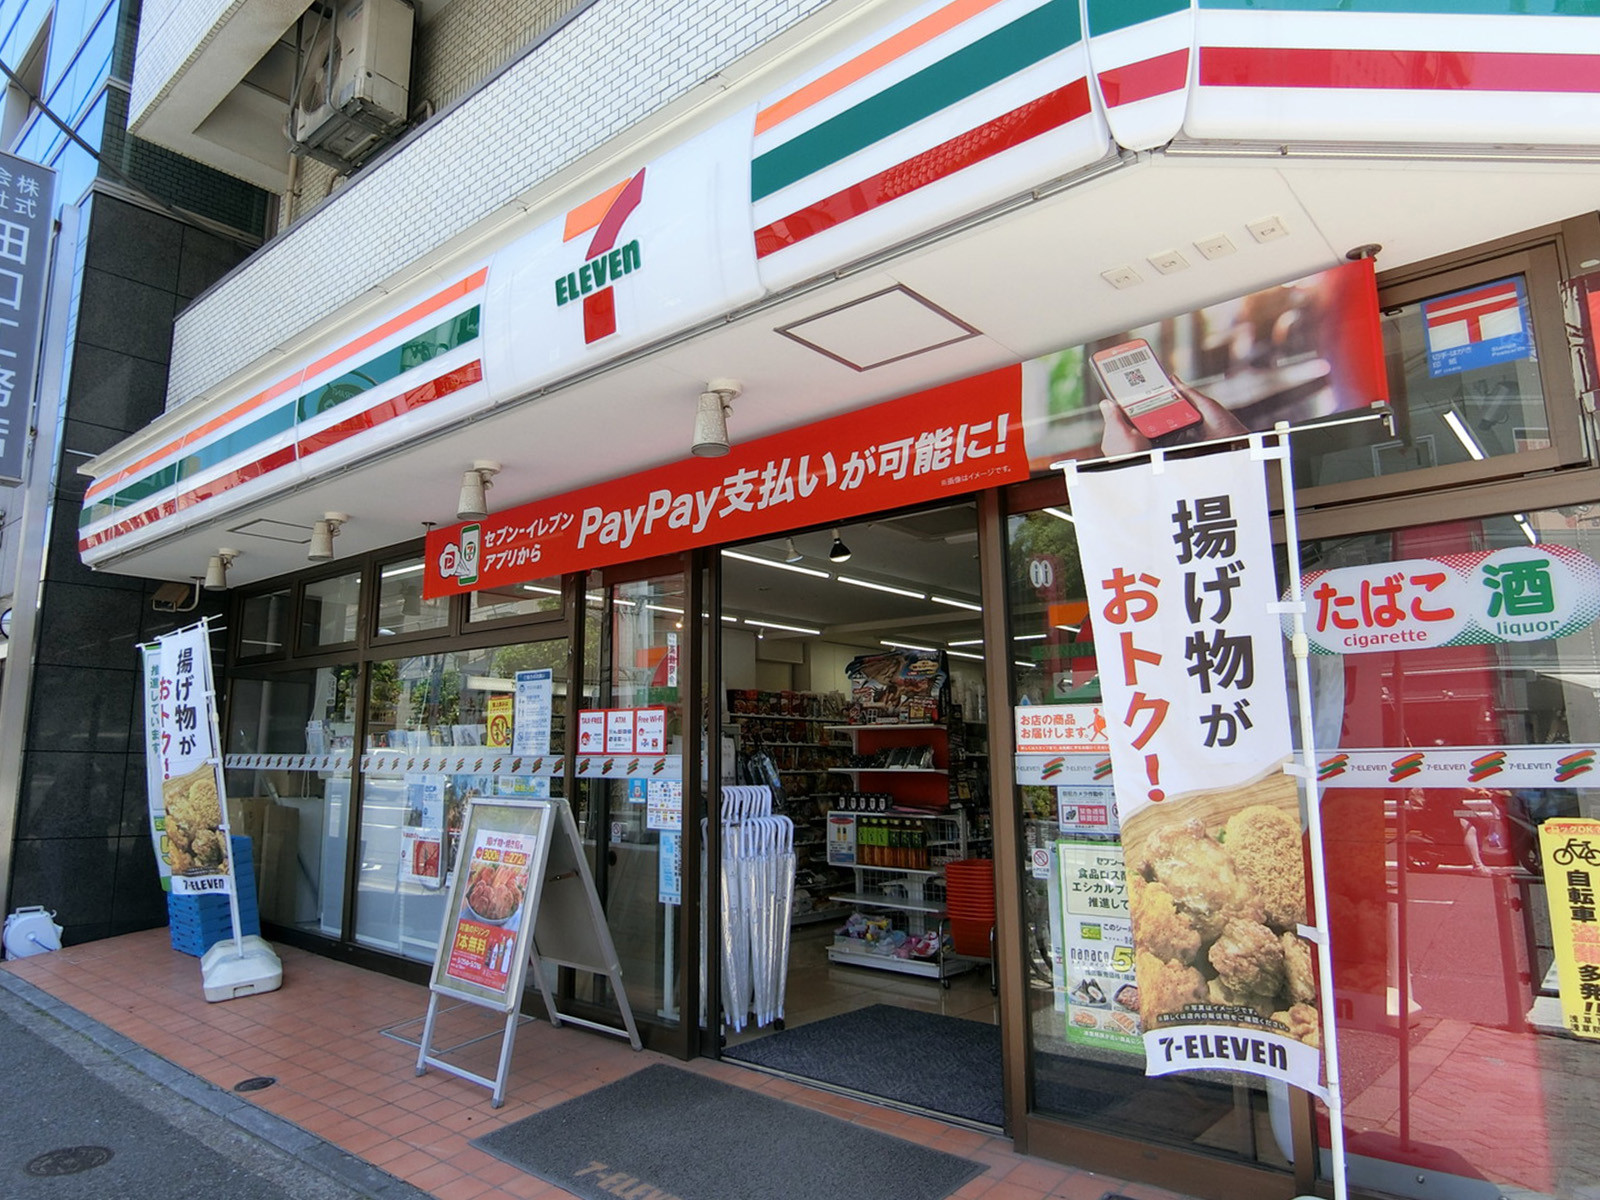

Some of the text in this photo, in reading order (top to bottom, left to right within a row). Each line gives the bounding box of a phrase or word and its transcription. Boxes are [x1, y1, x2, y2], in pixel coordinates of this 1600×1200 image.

[483, 544, 542, 572] アプリから
[1313, 572, 1455, 632] たばこ
[1482, 559, 1555, 618] 酒
[1172, 495, 1255, 748] 揚げ物が
[1497, 618, 1560, 637] liquor
[1343, 629, 1428, 648] cigarette
[1101, 567, 1171, 802] おトク!
[174, 647, 197, 756] 揚げ物が
[614, 716, 627, 724] ATM
[1020, 714, 1076, 726] お店の商品
[1020, 727, 1089, 739] お届けします。
